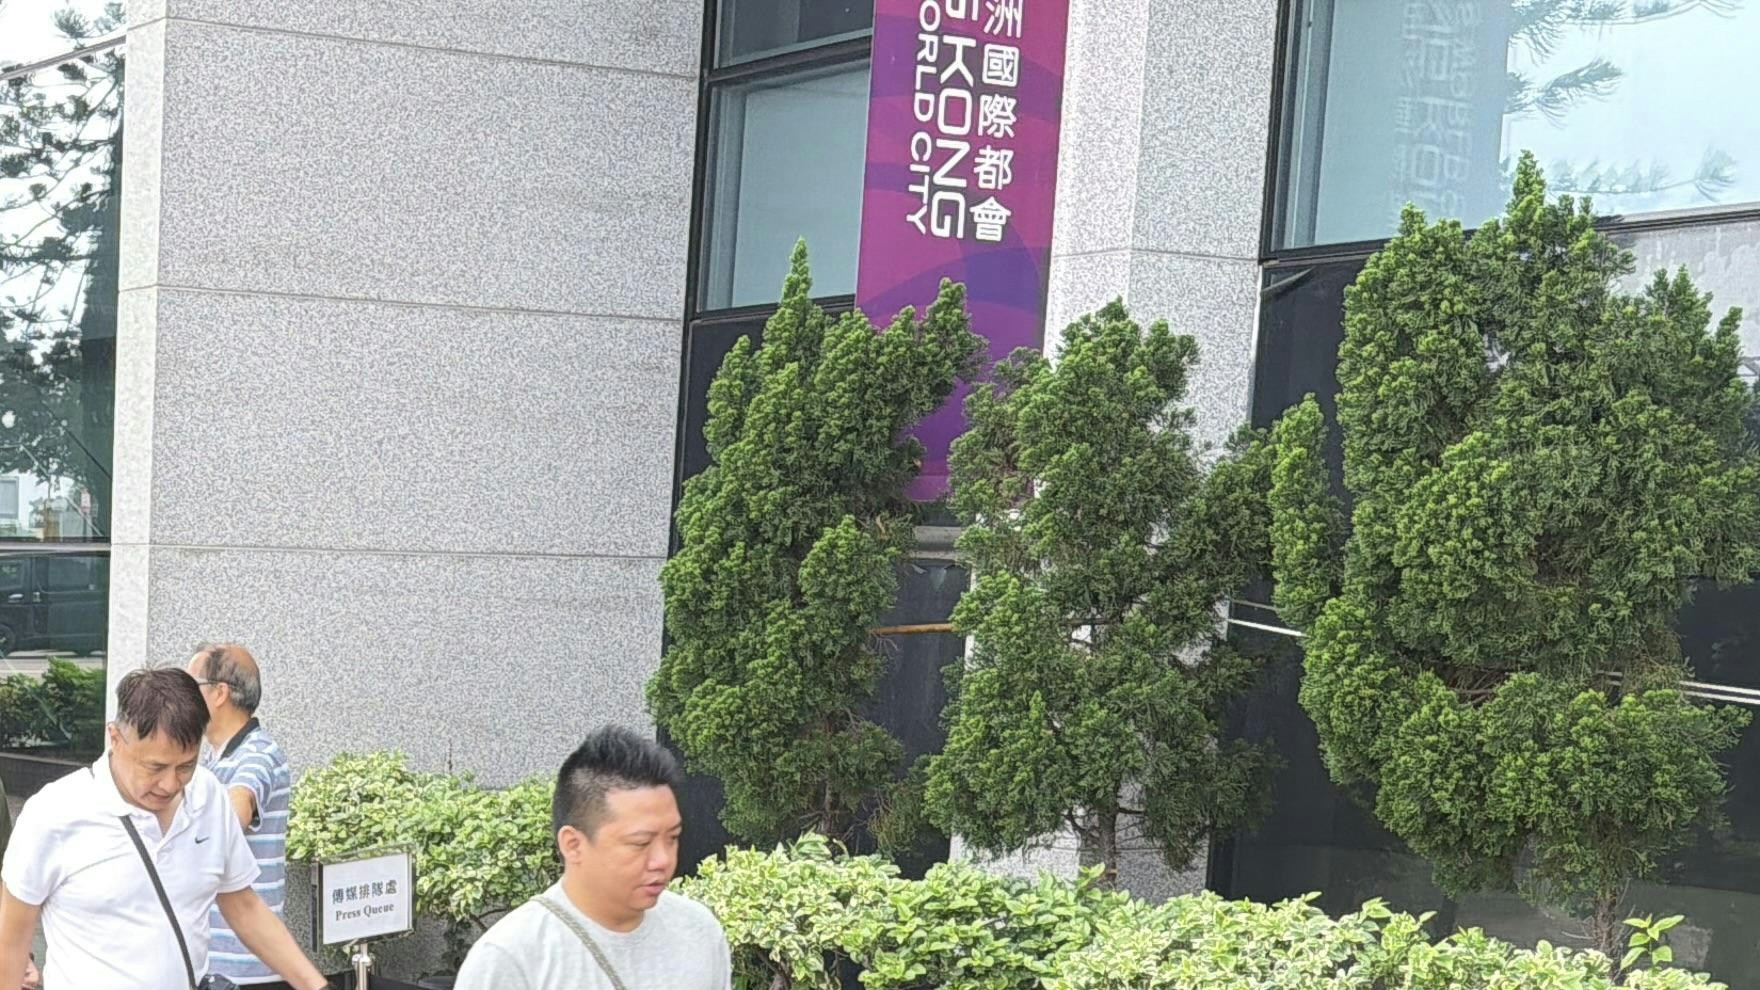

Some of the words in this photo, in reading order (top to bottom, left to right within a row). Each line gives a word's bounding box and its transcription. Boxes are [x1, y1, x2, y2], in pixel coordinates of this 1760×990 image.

[914, 0, 941, 122] ORLD
[931, 34, 977, 239] KONG
[969, 0, 1024, 242] 洲國際都會
[906, 131, 932, 235] CITY
[332, 879, 398, 905] 傳媒排隊處
[335, 909, 361, 922] Press
[363, 904, 394, 918] Queue
